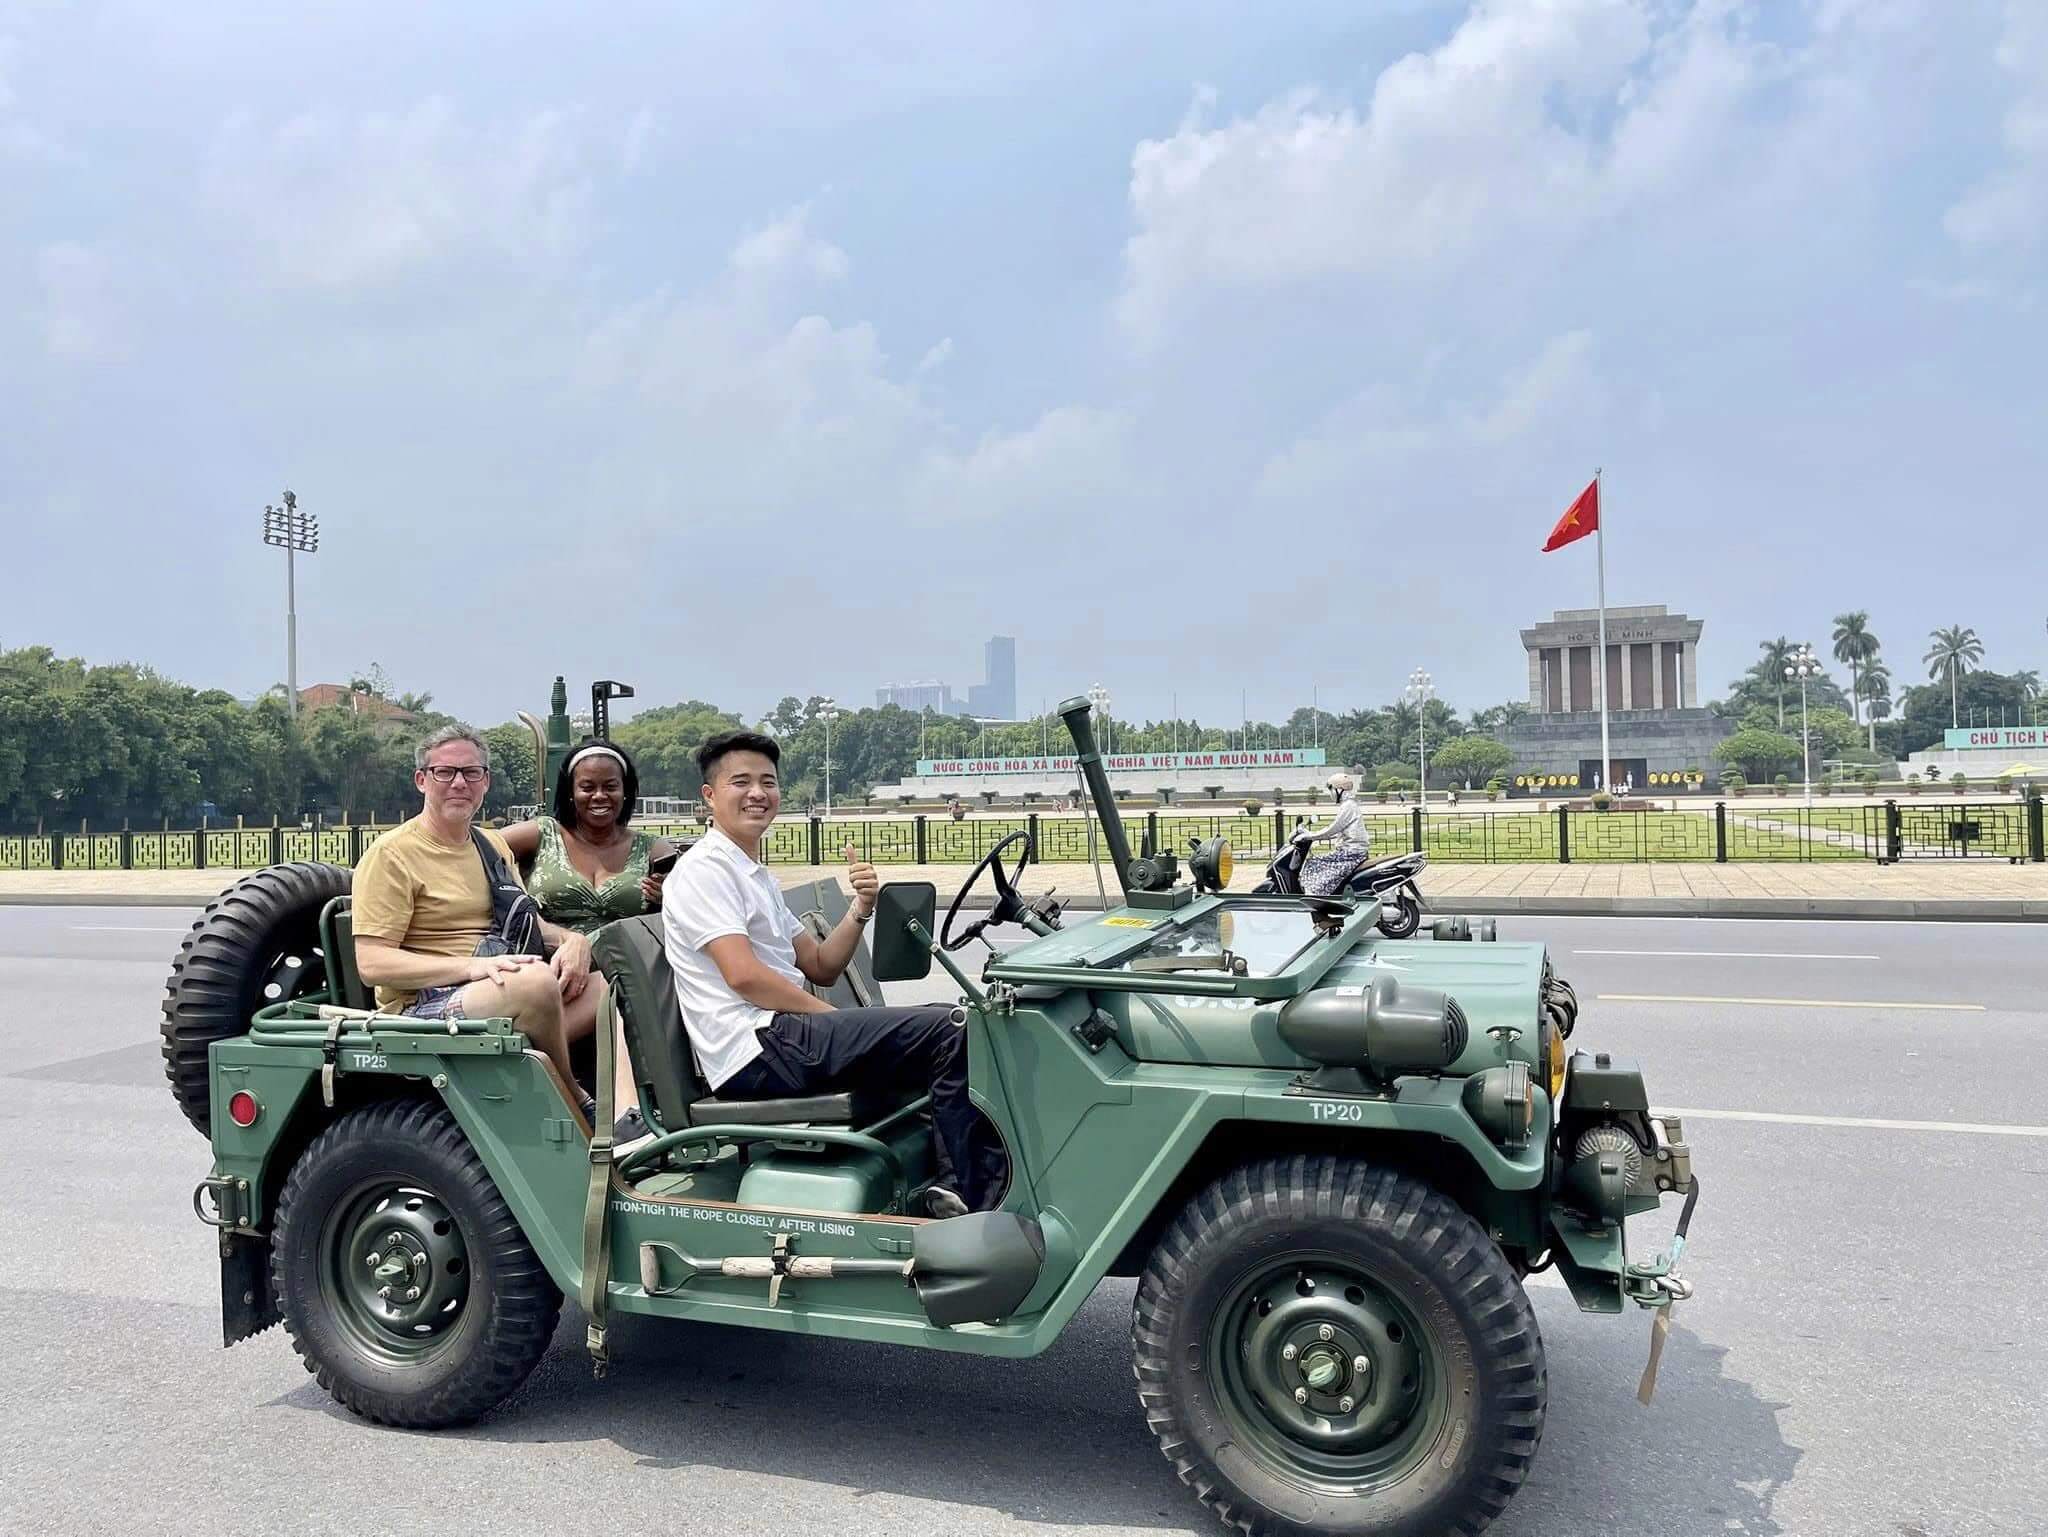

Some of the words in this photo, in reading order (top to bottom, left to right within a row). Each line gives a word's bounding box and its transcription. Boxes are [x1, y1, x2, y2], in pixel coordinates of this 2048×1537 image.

[1622, 630, 1653, 639] MINH
[1970, 729, 1998, 745] CHỦ
[2004, 731, 2036, 746] TỊCH
[1185, 755, 1213, 766] NAM
[1219, 752, 1257, 765] MUÔN
[352, 1054, 387, 1069] TP25
[1309, 1102, 1362, 1121] TP20
[611, 1200, 665, 1216] TION-TIGH
[668, 1206, 690, 1218] THE
[693, 1208, 723, 1222] ROPE
[726, 1212, 775, 1227] CLOSELY
[778, 1218, 816, 1233] AFTER
[819, 1222, 855, 1237] USING
